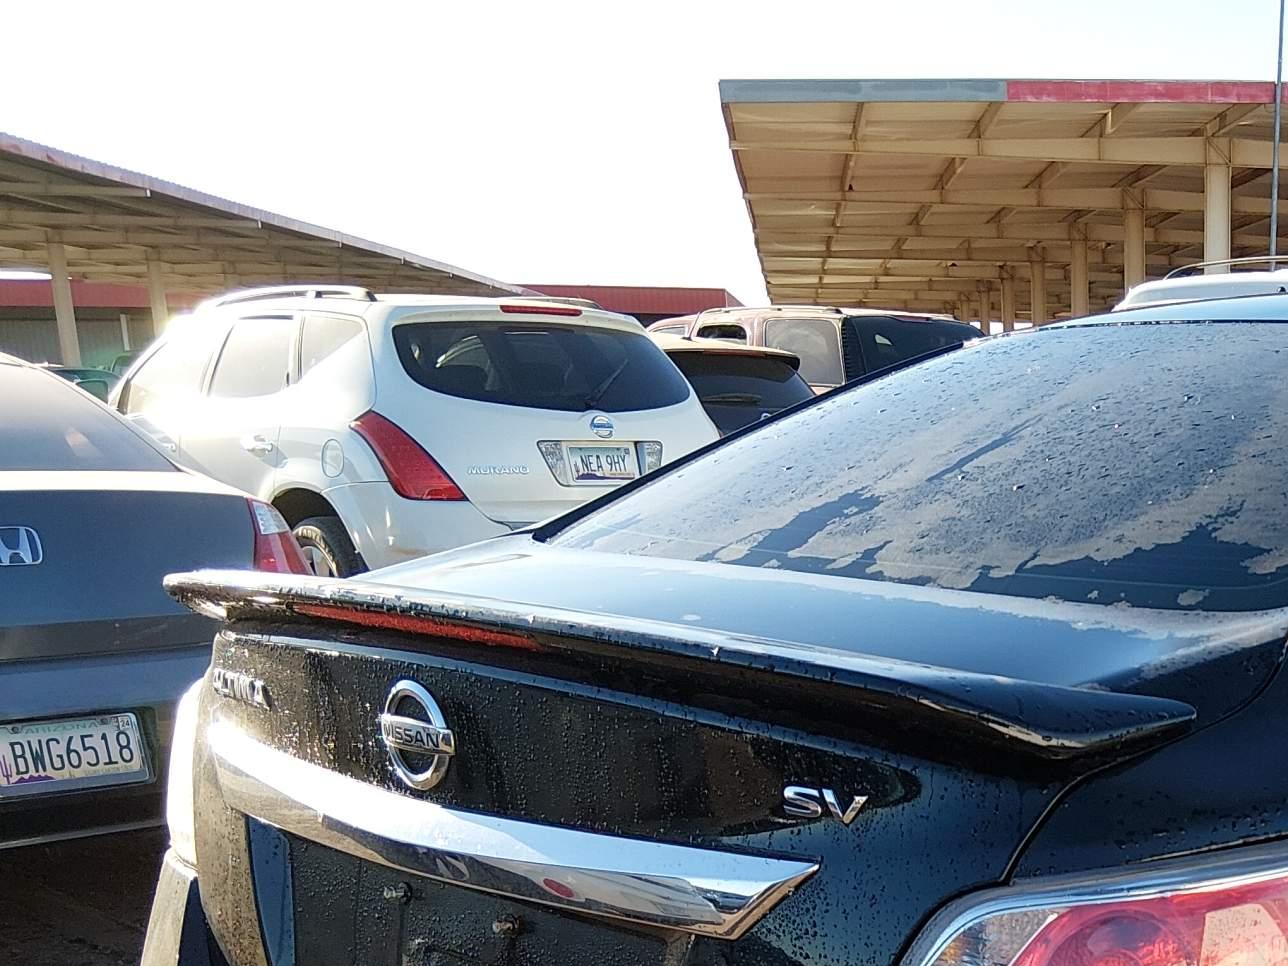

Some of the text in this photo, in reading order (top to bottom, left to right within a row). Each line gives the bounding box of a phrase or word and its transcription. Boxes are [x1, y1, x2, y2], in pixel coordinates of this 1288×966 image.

[580, 455, 627, 472] NEA 9HY
[383, 723, 441, 748] NISSAN
[9, 731, 134, 776] BWG6518
[783, 785, 869, 824] SV
